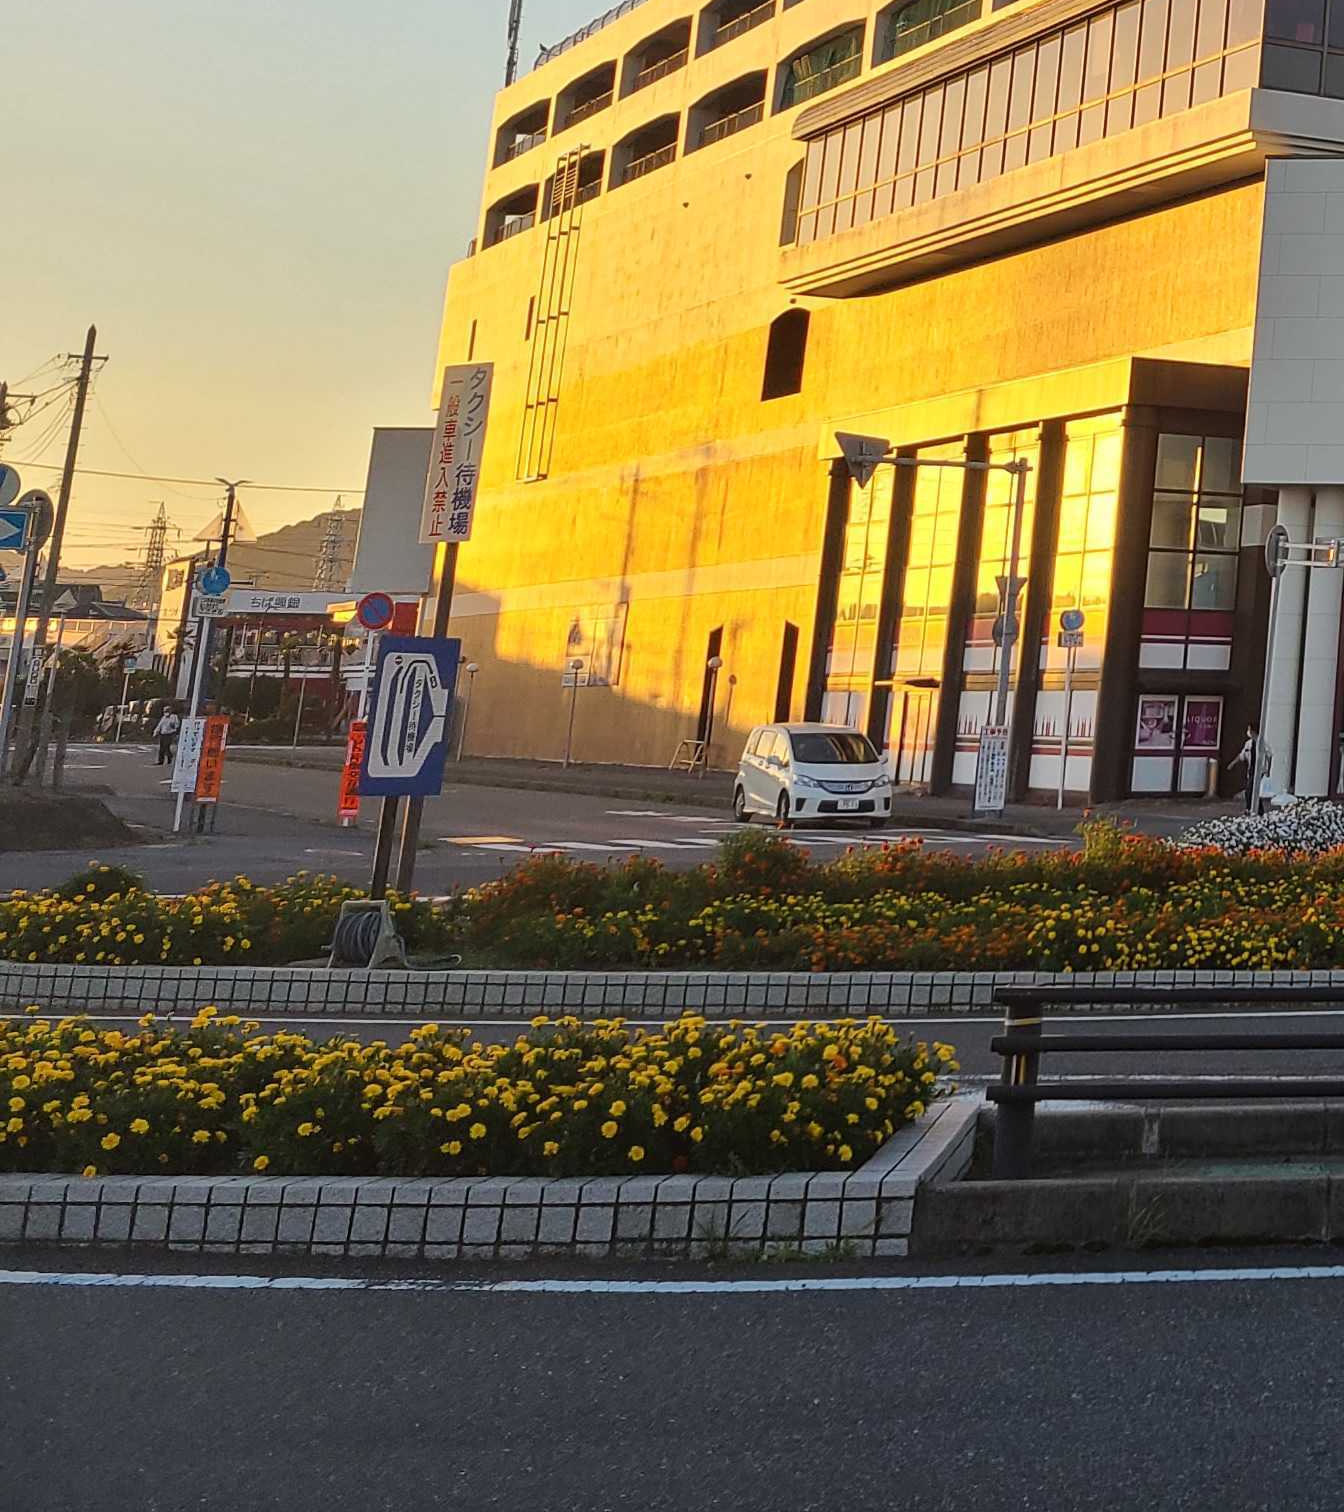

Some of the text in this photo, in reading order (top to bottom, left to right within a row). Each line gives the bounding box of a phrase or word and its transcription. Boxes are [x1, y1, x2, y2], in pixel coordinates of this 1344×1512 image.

[428, 379, 464, 537] 一般車進入禁止
[447, 367, 488, 535] タクシー待機場
